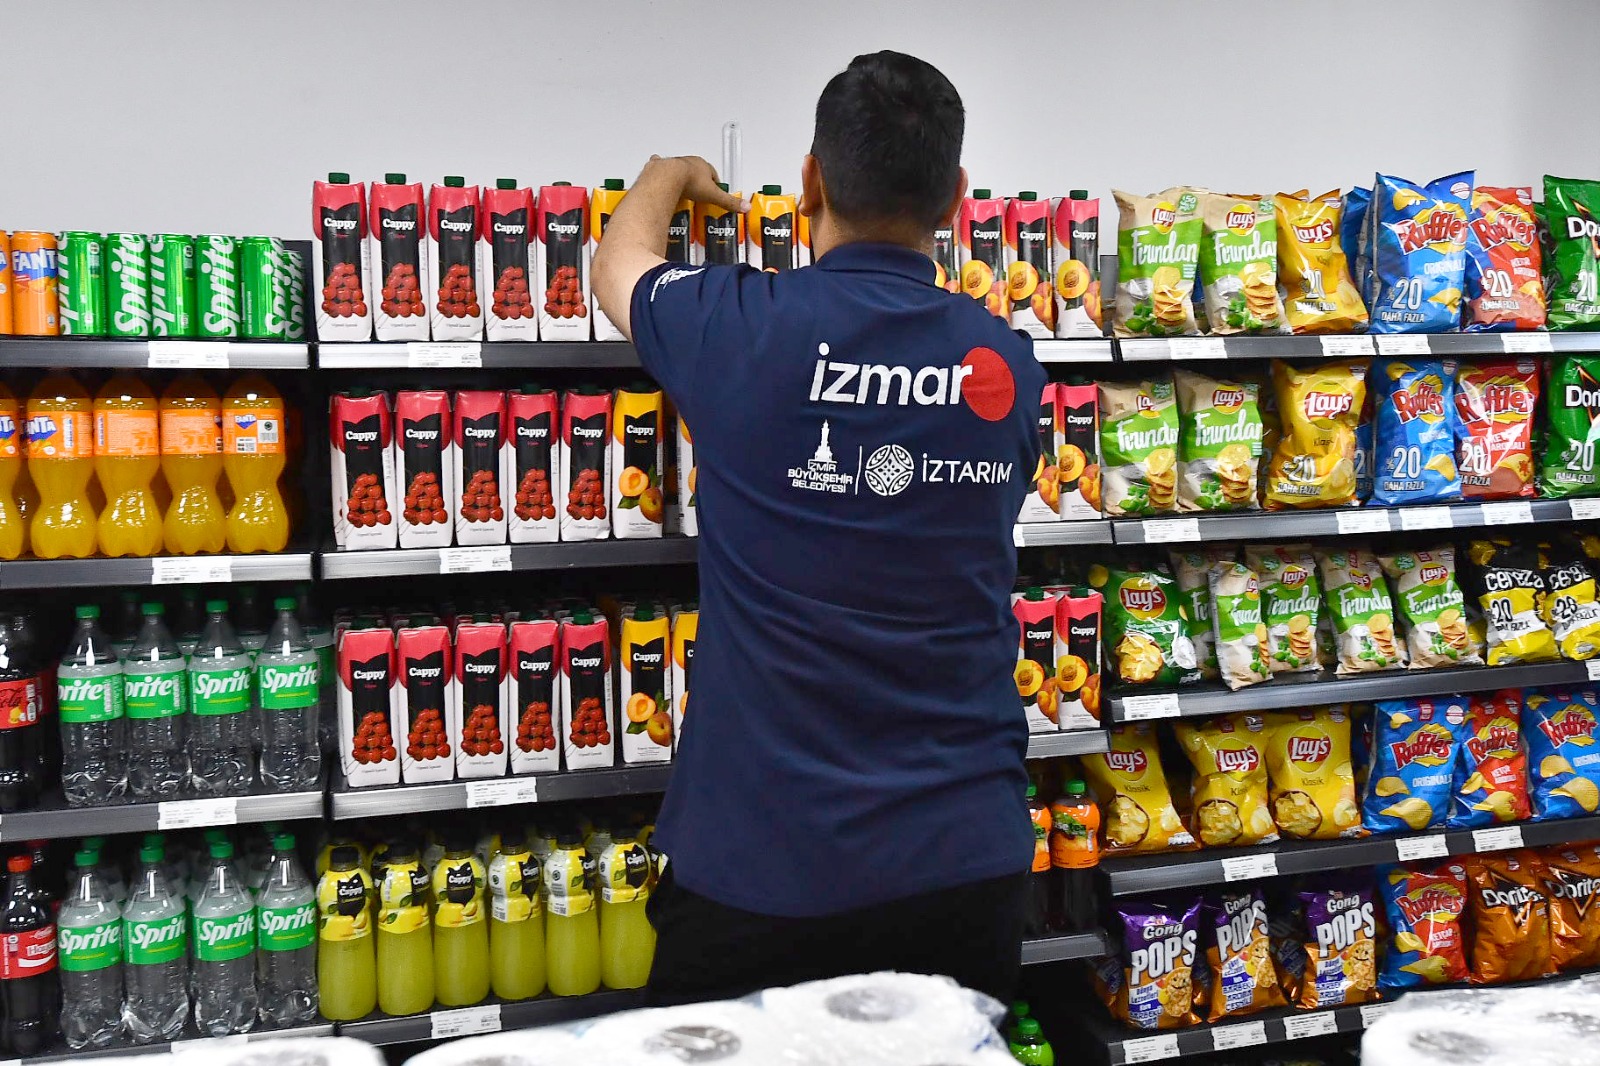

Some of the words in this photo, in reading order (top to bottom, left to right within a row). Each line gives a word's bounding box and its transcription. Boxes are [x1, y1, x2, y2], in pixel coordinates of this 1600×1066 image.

[324, 218, 357, 230] Cappy
[383, 218, 416, 230] Cappy
[440, 219, 472, 232] Cappy
[494, 223, 525, 234] Cappy
[548, 222, 579, 234] Cappy
[667, 226, 688, 236] ppy
[708, 226, 736, 236] Cappy
[764, 226, 792, 237] Cappy
[934, 229, 952, 239] ppy
[973, 230, 1000, 240] Cappy
[1020, 231, 1046, 241] Cappy
[1072, 230, 1097, 240] Cappy
[1396, 211, 1468, 255] Ruffles
[1469, 211, 1536, 252] Ruffles
[12, 249, 58, 272] FANT
[111, 234, 148, 337] Sprite
[201, 234, 236, 337] Sprite
[1381, 312, 1402, 322] DAHA
[1403, 312, 1425, 323] FAZLA
[809, 342, 973, 406] izmar
[1305, 391, 1353, 420] Lay's
[1391, 382, 1445, 425] Ruffles
[1454, 384, 1535, 425] Rffles
[1067, 415, 1094, 425] Cappy
[346, 431, 377, 442] Cappy
[406, 428, 439, 440] Cappy
[465, 427, 497, 438] Cappy
[517, 426, 548, 438] Cappy
[573, 426, 604, 438] Cappy
[626, 424, 656, 436] Cappy
[922, 452, 1013, 484] İZTARIM
[787, 467, 854, 486] BÜYÜKŞEHİR
[1470, 475, 1492, 487] FAZLA
[791, 480, 847, 494] BELEDİYESİ
[1384, 481, 1404, 491] DAHA
[1405, 480, 1425, 491] FAZLA
[1122, 588, 1163, 612] Lay's
[1026, 630, 1052, 640] Cappy
[1071, 626, 1096, 636] Cappy
[571, 656, 601, 668] Cappy
[633, 652, 662, 663] Cappy
[409, 666, 441, 678] Cappy
[465, 663, 497, 674] Cappy
[520, 660, 551, 672] Cappy
[263, 665, 317, 693] Sprite
[353, 669, 386, 681] Cappy
[1537, 711, 1598, 749] Ruffles
[1290, 737, 1331, 763] Lay's
[1390, 731, 1452, 771] Ruffles
[1107, 751, 1147, 773] Lay's
[1218, 747, 1259, 772] Lay's
[1482, 886, 1544, 908] Doritos
[1326, 894, 1360, 914] Gong
[1394, 889, 1465, 926] Ruffles
[259, 904, 317, 934] Sprite
[130, 915, 187, 951] Sprite
[200, 913, 255, 944] Sprite
[1143, 922, 1184, 941] Gong
[1216, 900, 1269, 963] POPS
[1316, 901, 1376, 958] POPS
[59, 923, 120, 955] Sprite
[1130, 929, 1198, 987] POPS
